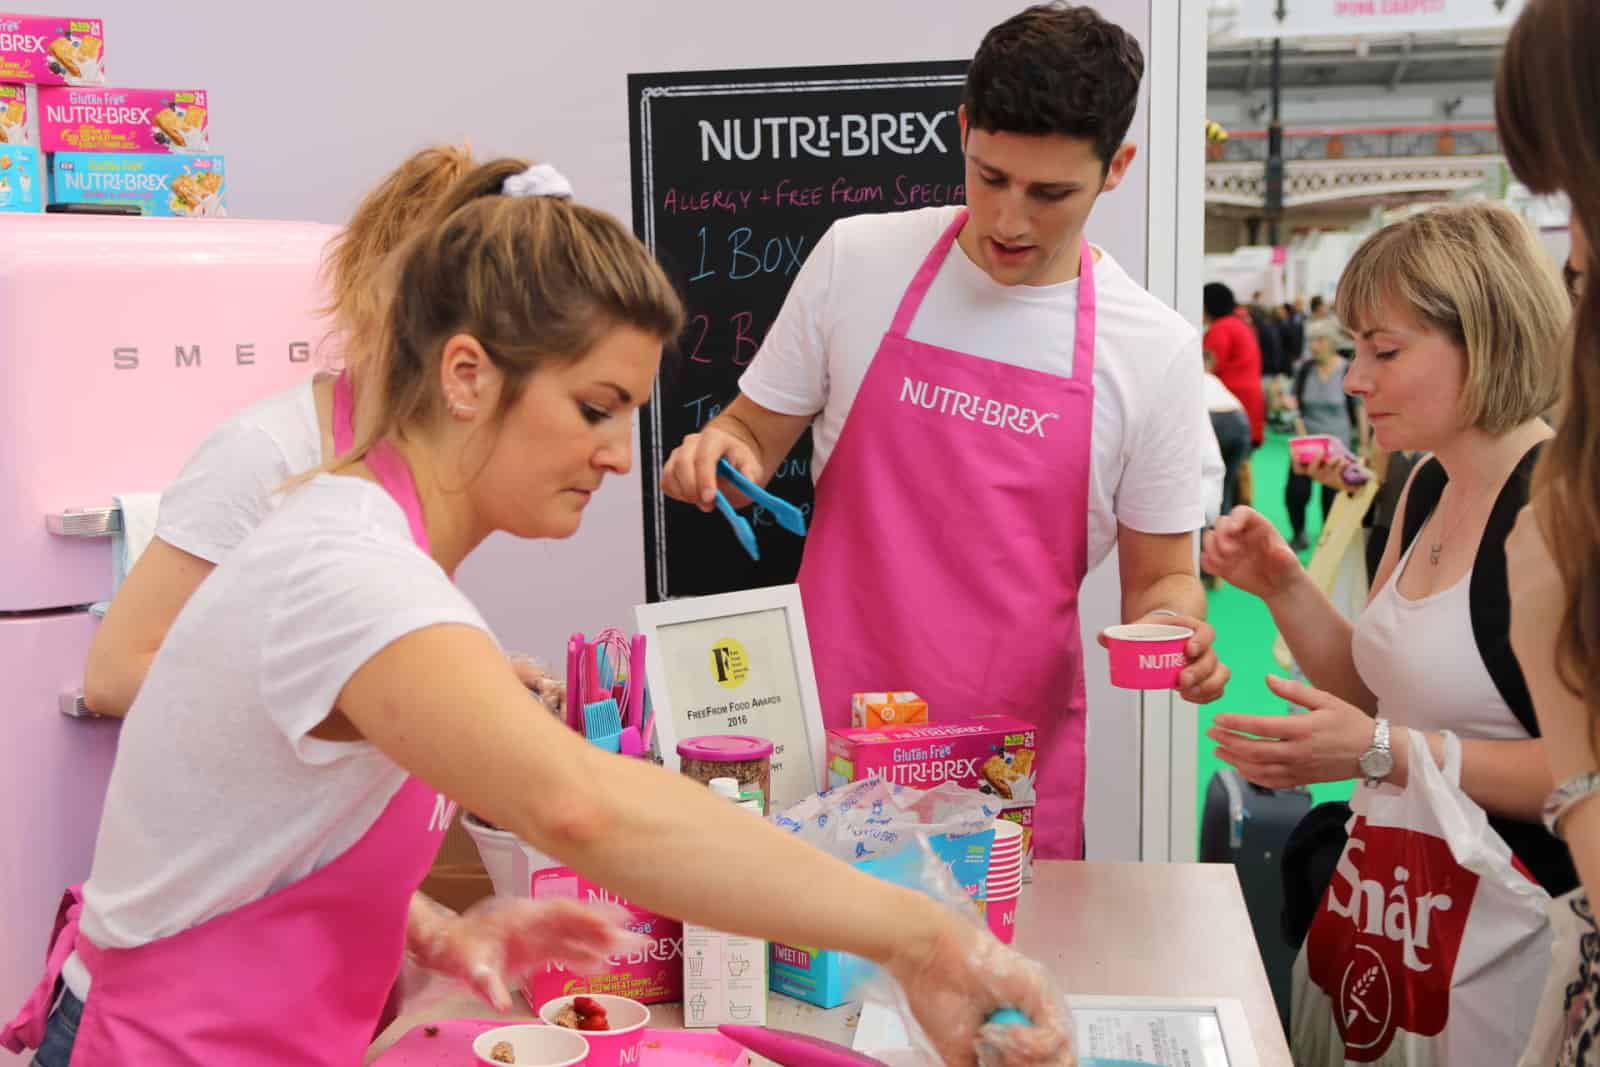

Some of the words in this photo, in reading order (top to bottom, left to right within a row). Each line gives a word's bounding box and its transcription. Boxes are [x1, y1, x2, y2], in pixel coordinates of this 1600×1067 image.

[46, 104, 152, 126] NUTRI-BREX
[698, 111, 949, 161] NUTRI-BREX
[64, 172, 169, 192] NUTRI-BREX
[664, 186, 751, 214] ALLERGY
[689, 225, 716, 282] 1
[728, 226, 804, 280] BOX
[690, 313, 713, 365] 2
[730, 311, 768, 367] B
[112, 341, 310, 370] SMEG
[900, 377, 1048, 438] NUTRI-BREX
[727, 715, 748, 728] 2016
[893, 746, 928, 763] Gluten
[930, 743, 953, 759] Free
[867, 757, 978, 785] NUTRI-BREX
